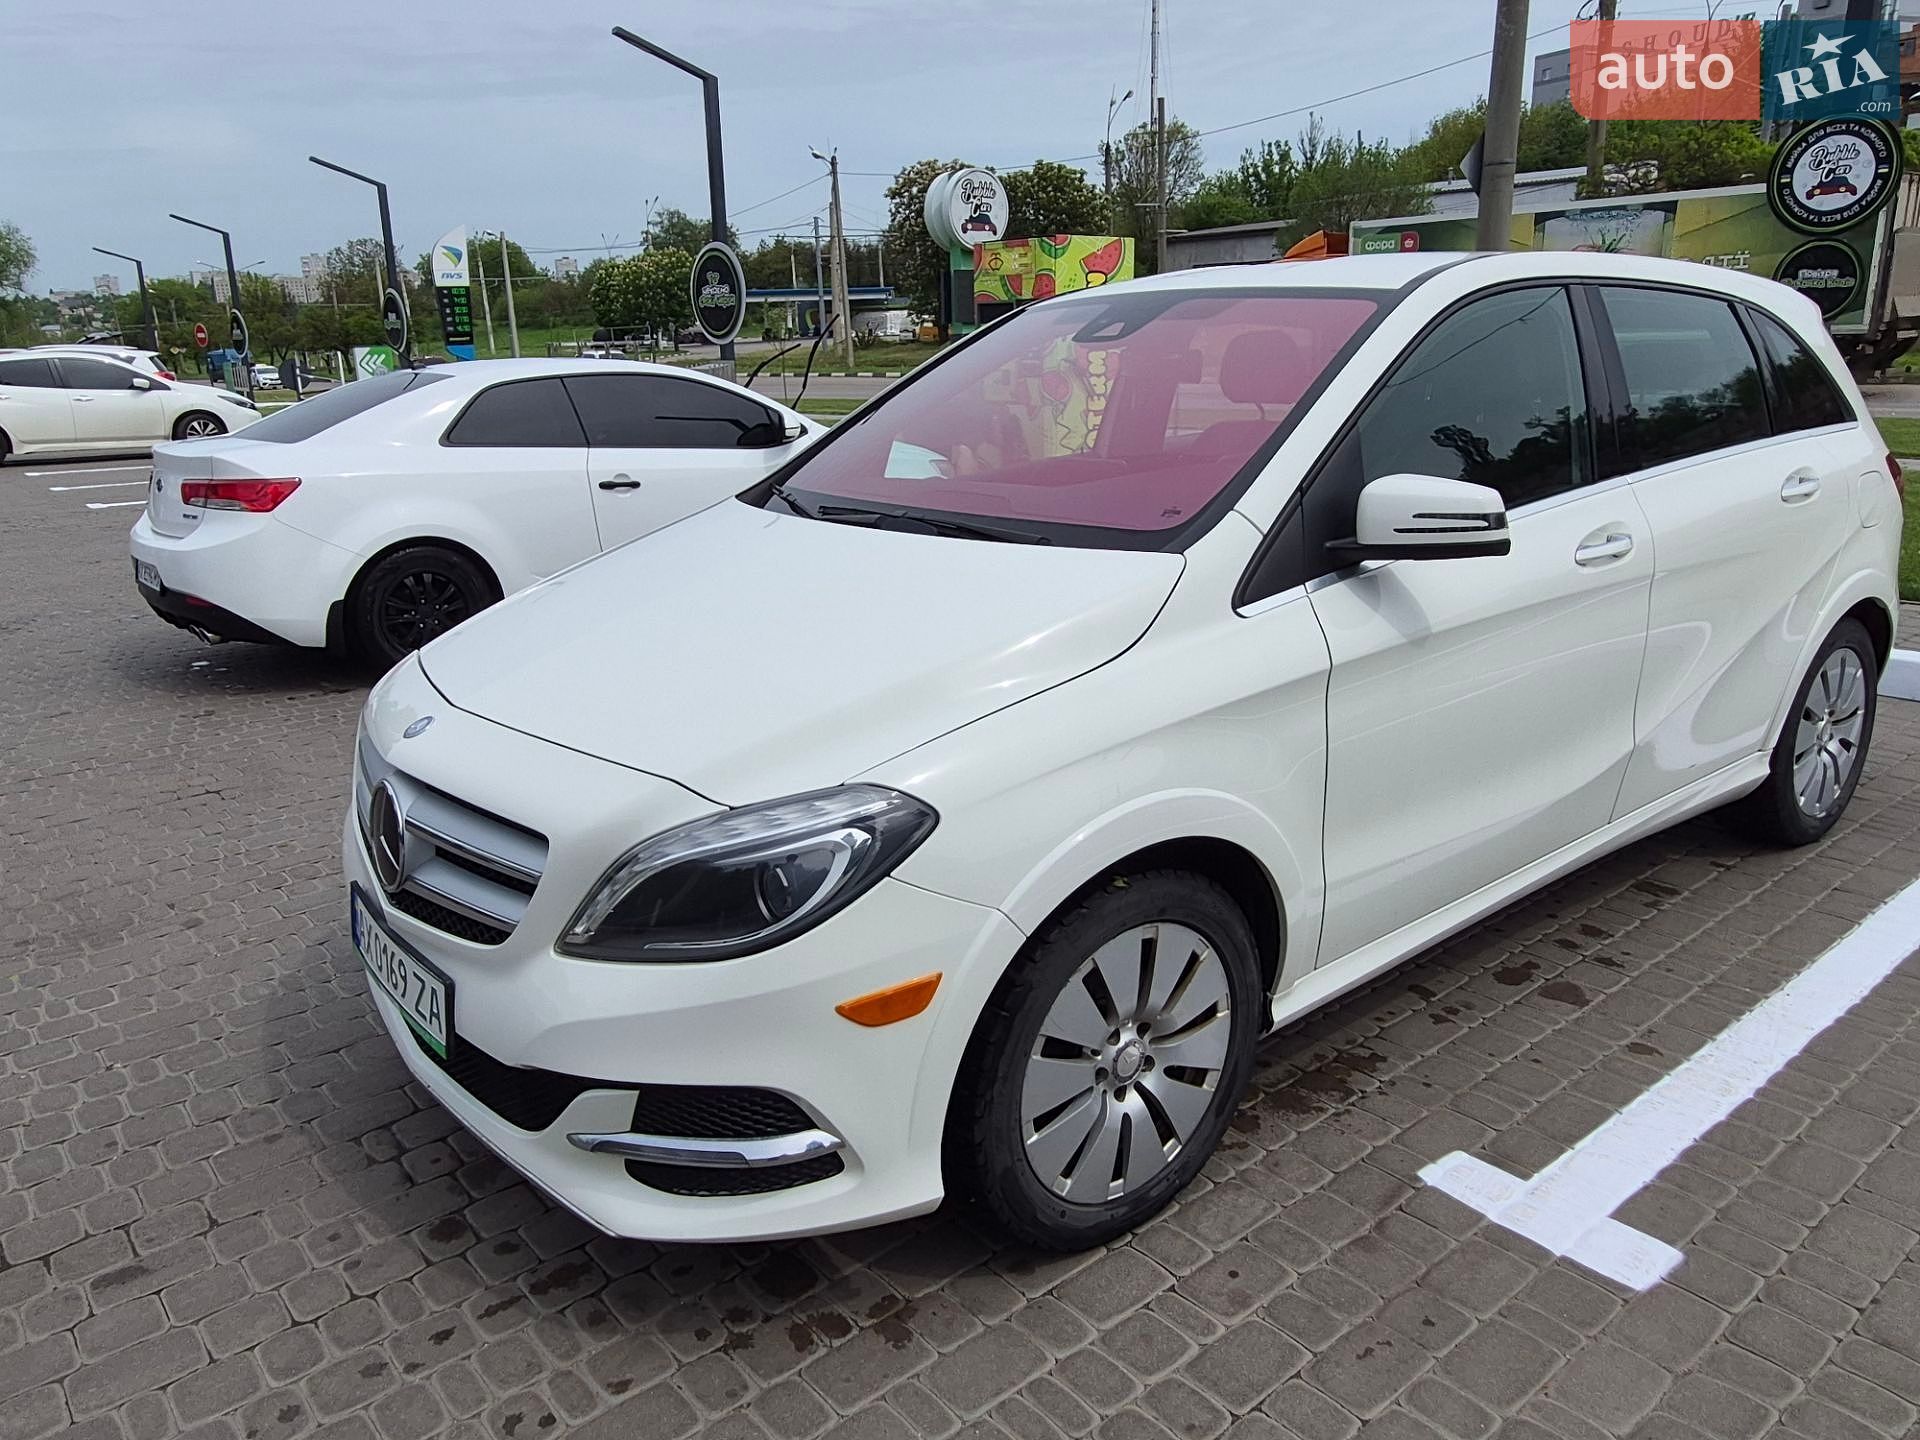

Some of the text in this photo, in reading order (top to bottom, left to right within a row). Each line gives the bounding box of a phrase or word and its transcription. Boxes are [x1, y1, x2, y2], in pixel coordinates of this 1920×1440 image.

[1809, 143, 1860, 171] Bubble
[1821, 161, 1853, 182] Car
[961, 178, 996, 204] Bubble
[375, 932, 408, 999] 0169
[412, 970, 443, 1034] ZA
